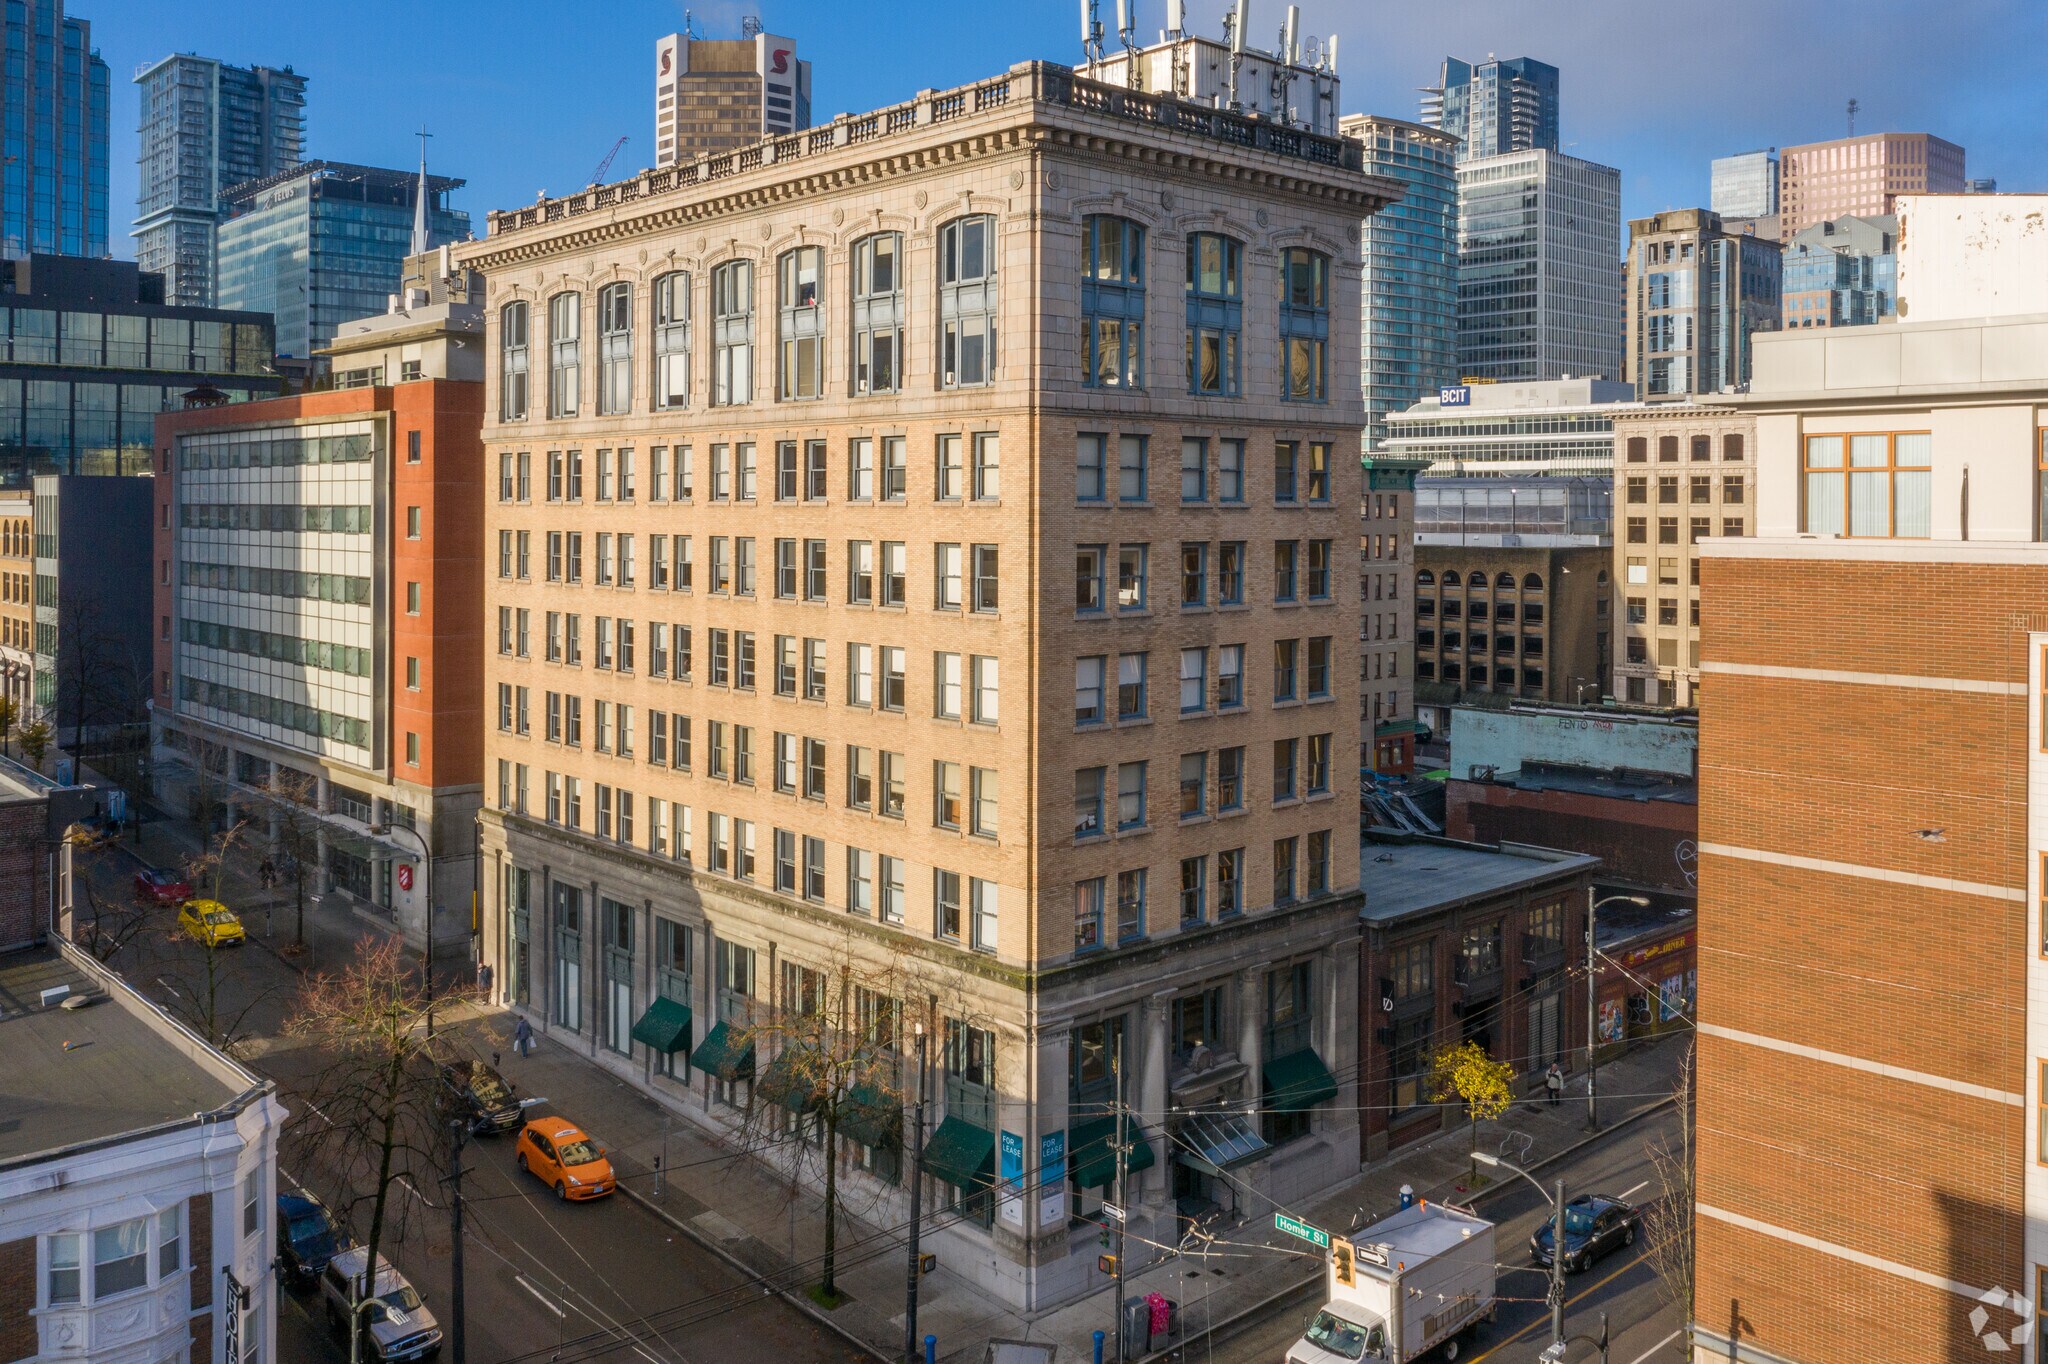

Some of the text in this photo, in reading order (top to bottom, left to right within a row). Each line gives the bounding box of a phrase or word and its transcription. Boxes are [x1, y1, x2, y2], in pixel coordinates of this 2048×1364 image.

[273, 186, 295, 203] TELUS
[1441, 389, 1467, 403] BCIT
[1002, 1135, 1015, 1147] FOR
[1042, 1138, 1056, 1149] FOR
[1002, 1144, 1022, 1159] LEASE
[1042, 1144, 1063, 1158] LEASE
[1280, 1217, 1324, 1244] Homer St
